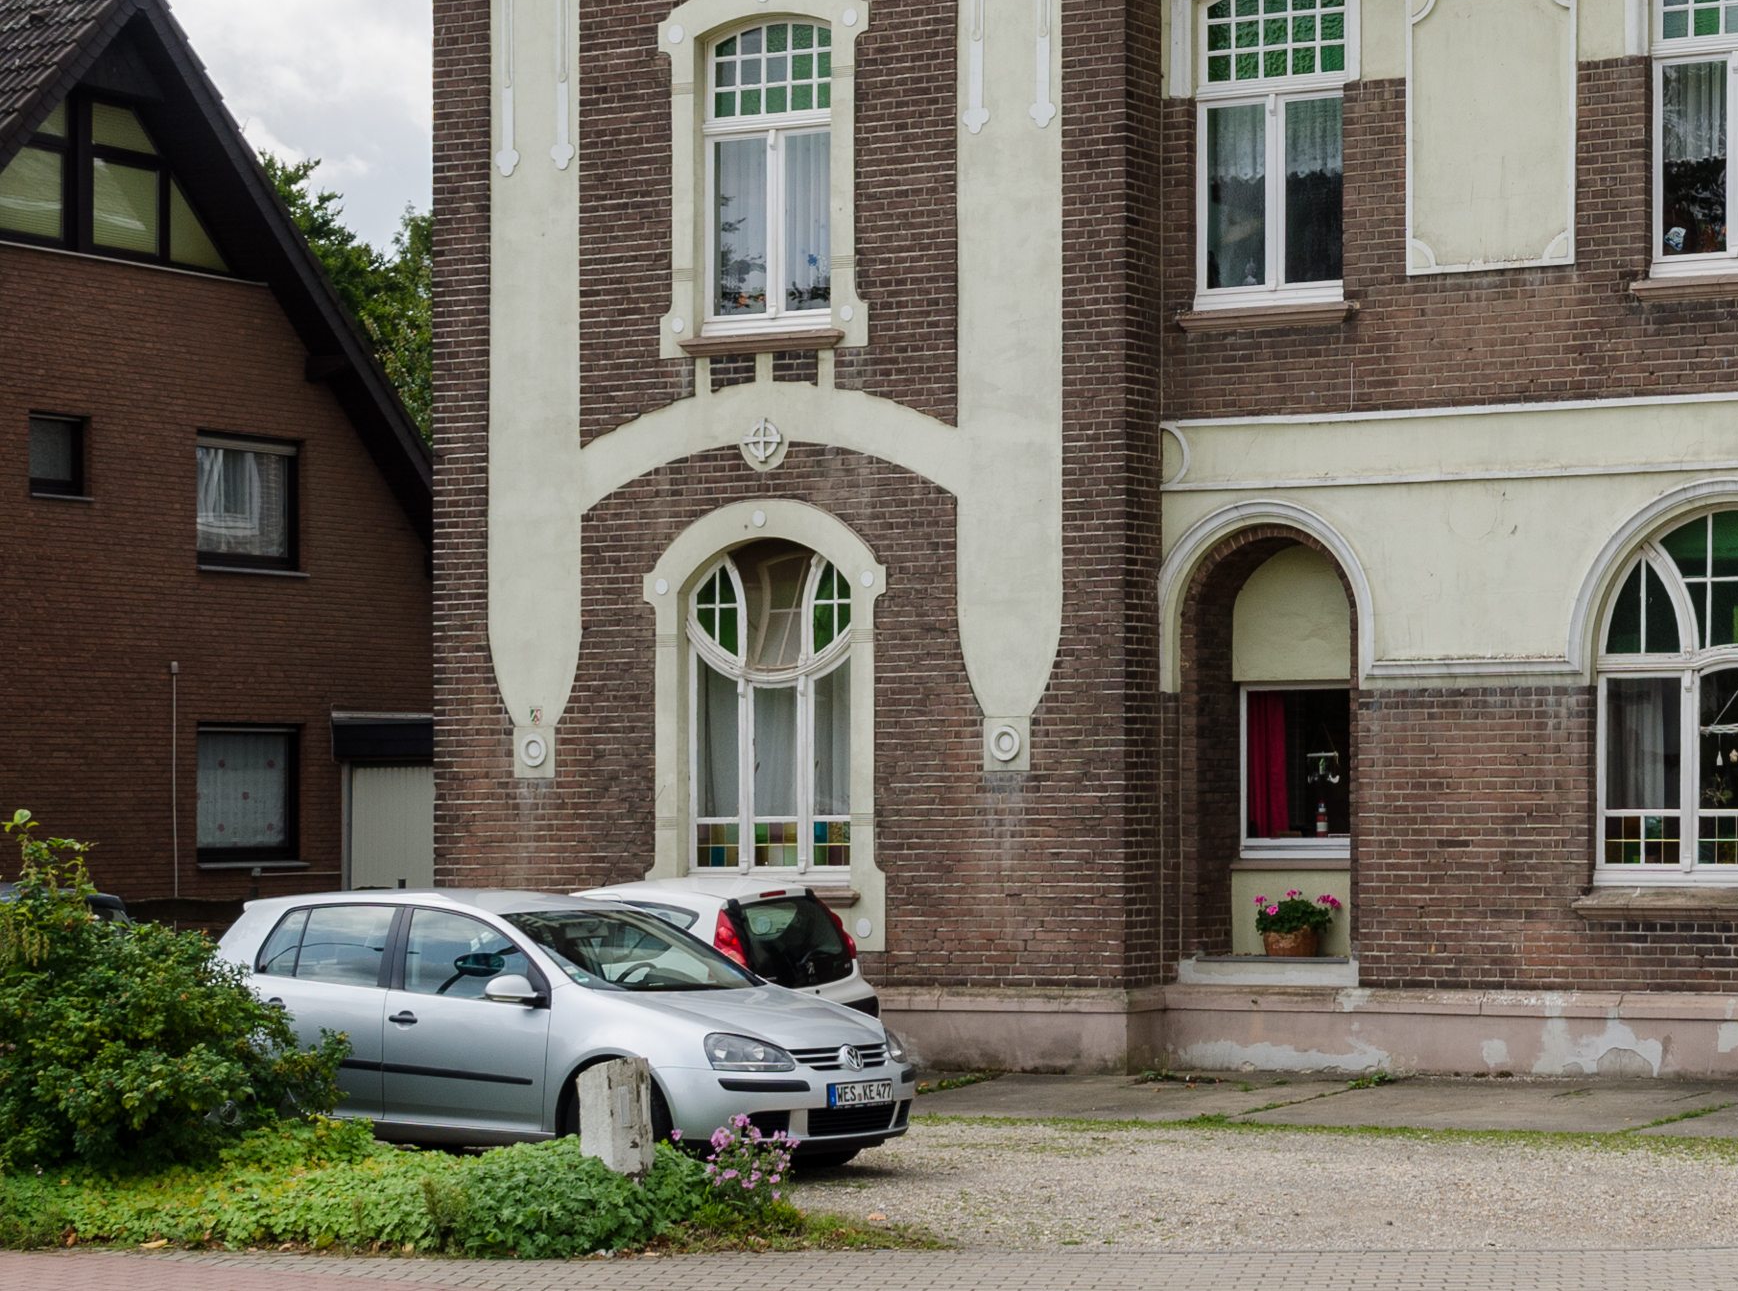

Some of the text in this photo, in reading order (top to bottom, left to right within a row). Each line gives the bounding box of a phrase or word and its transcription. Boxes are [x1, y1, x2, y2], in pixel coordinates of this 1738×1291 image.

[836, 1082, 892, 1103] WES KE 477
